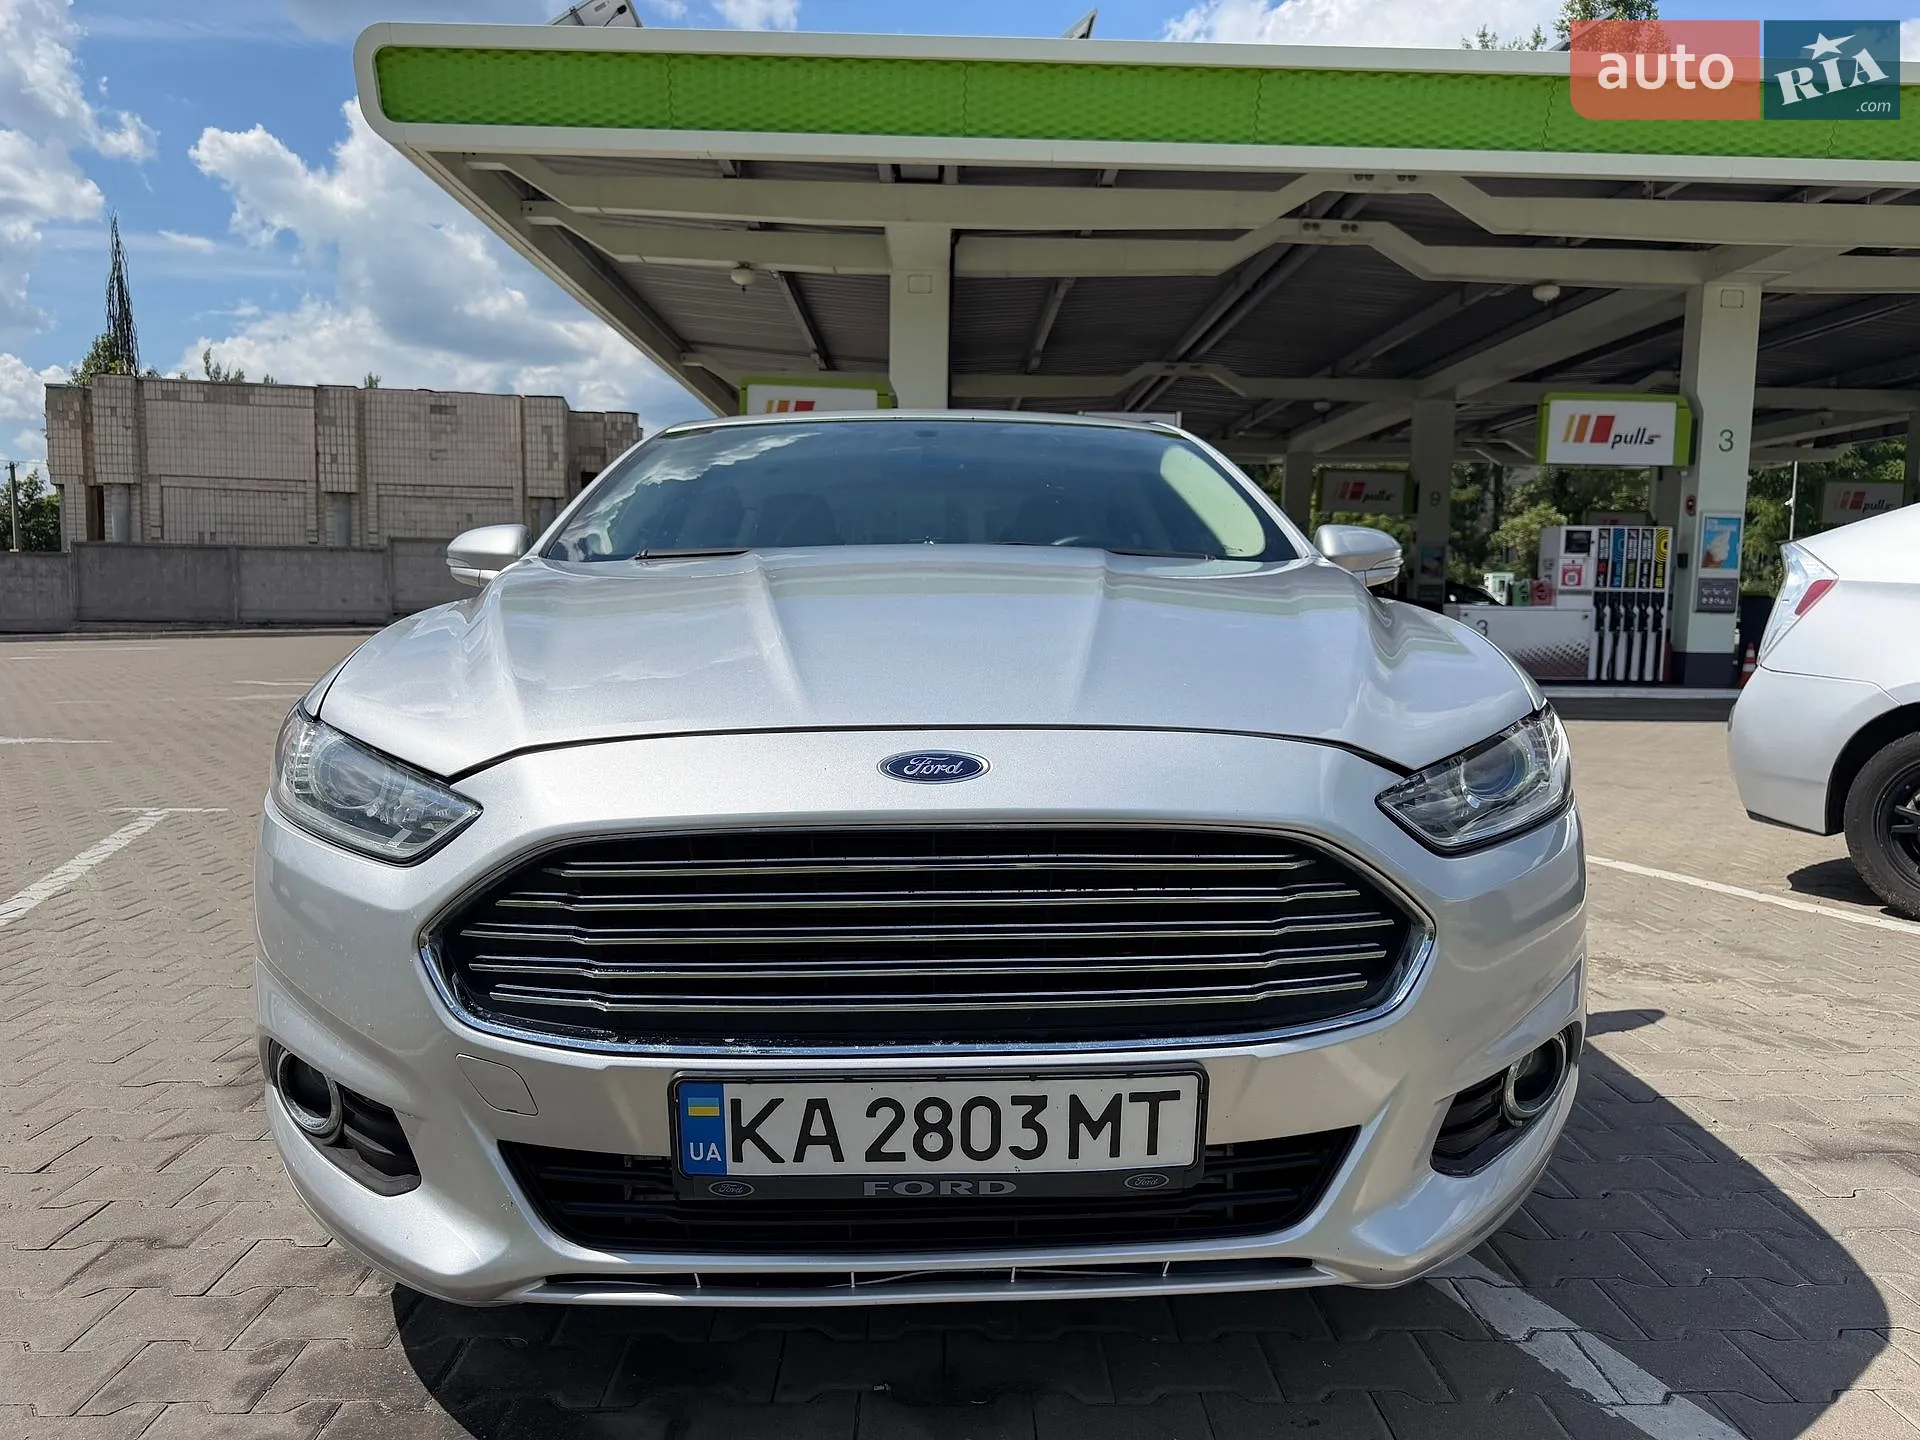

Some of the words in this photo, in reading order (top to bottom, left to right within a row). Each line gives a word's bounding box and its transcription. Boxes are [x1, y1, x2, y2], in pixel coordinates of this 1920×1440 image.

[1611, 427, 1661, 450] pulls
[1718, 429, 1734, 452] 3
[1476, 619, 1489, 637] 3
[903, 756, 964, 775] Ford
[729, 1096, 846, 1164] KA
[864, 1094, 1049, 1163] 2803
[1067, 1089, 1182, 1160] MT
[689, 1142, 722, 1162] UA
[719, 1183, 745, 1194] Ford
[863, 1179, 1018, 1198] FORD
[1134, 1175, 1160, 1186] Ford
